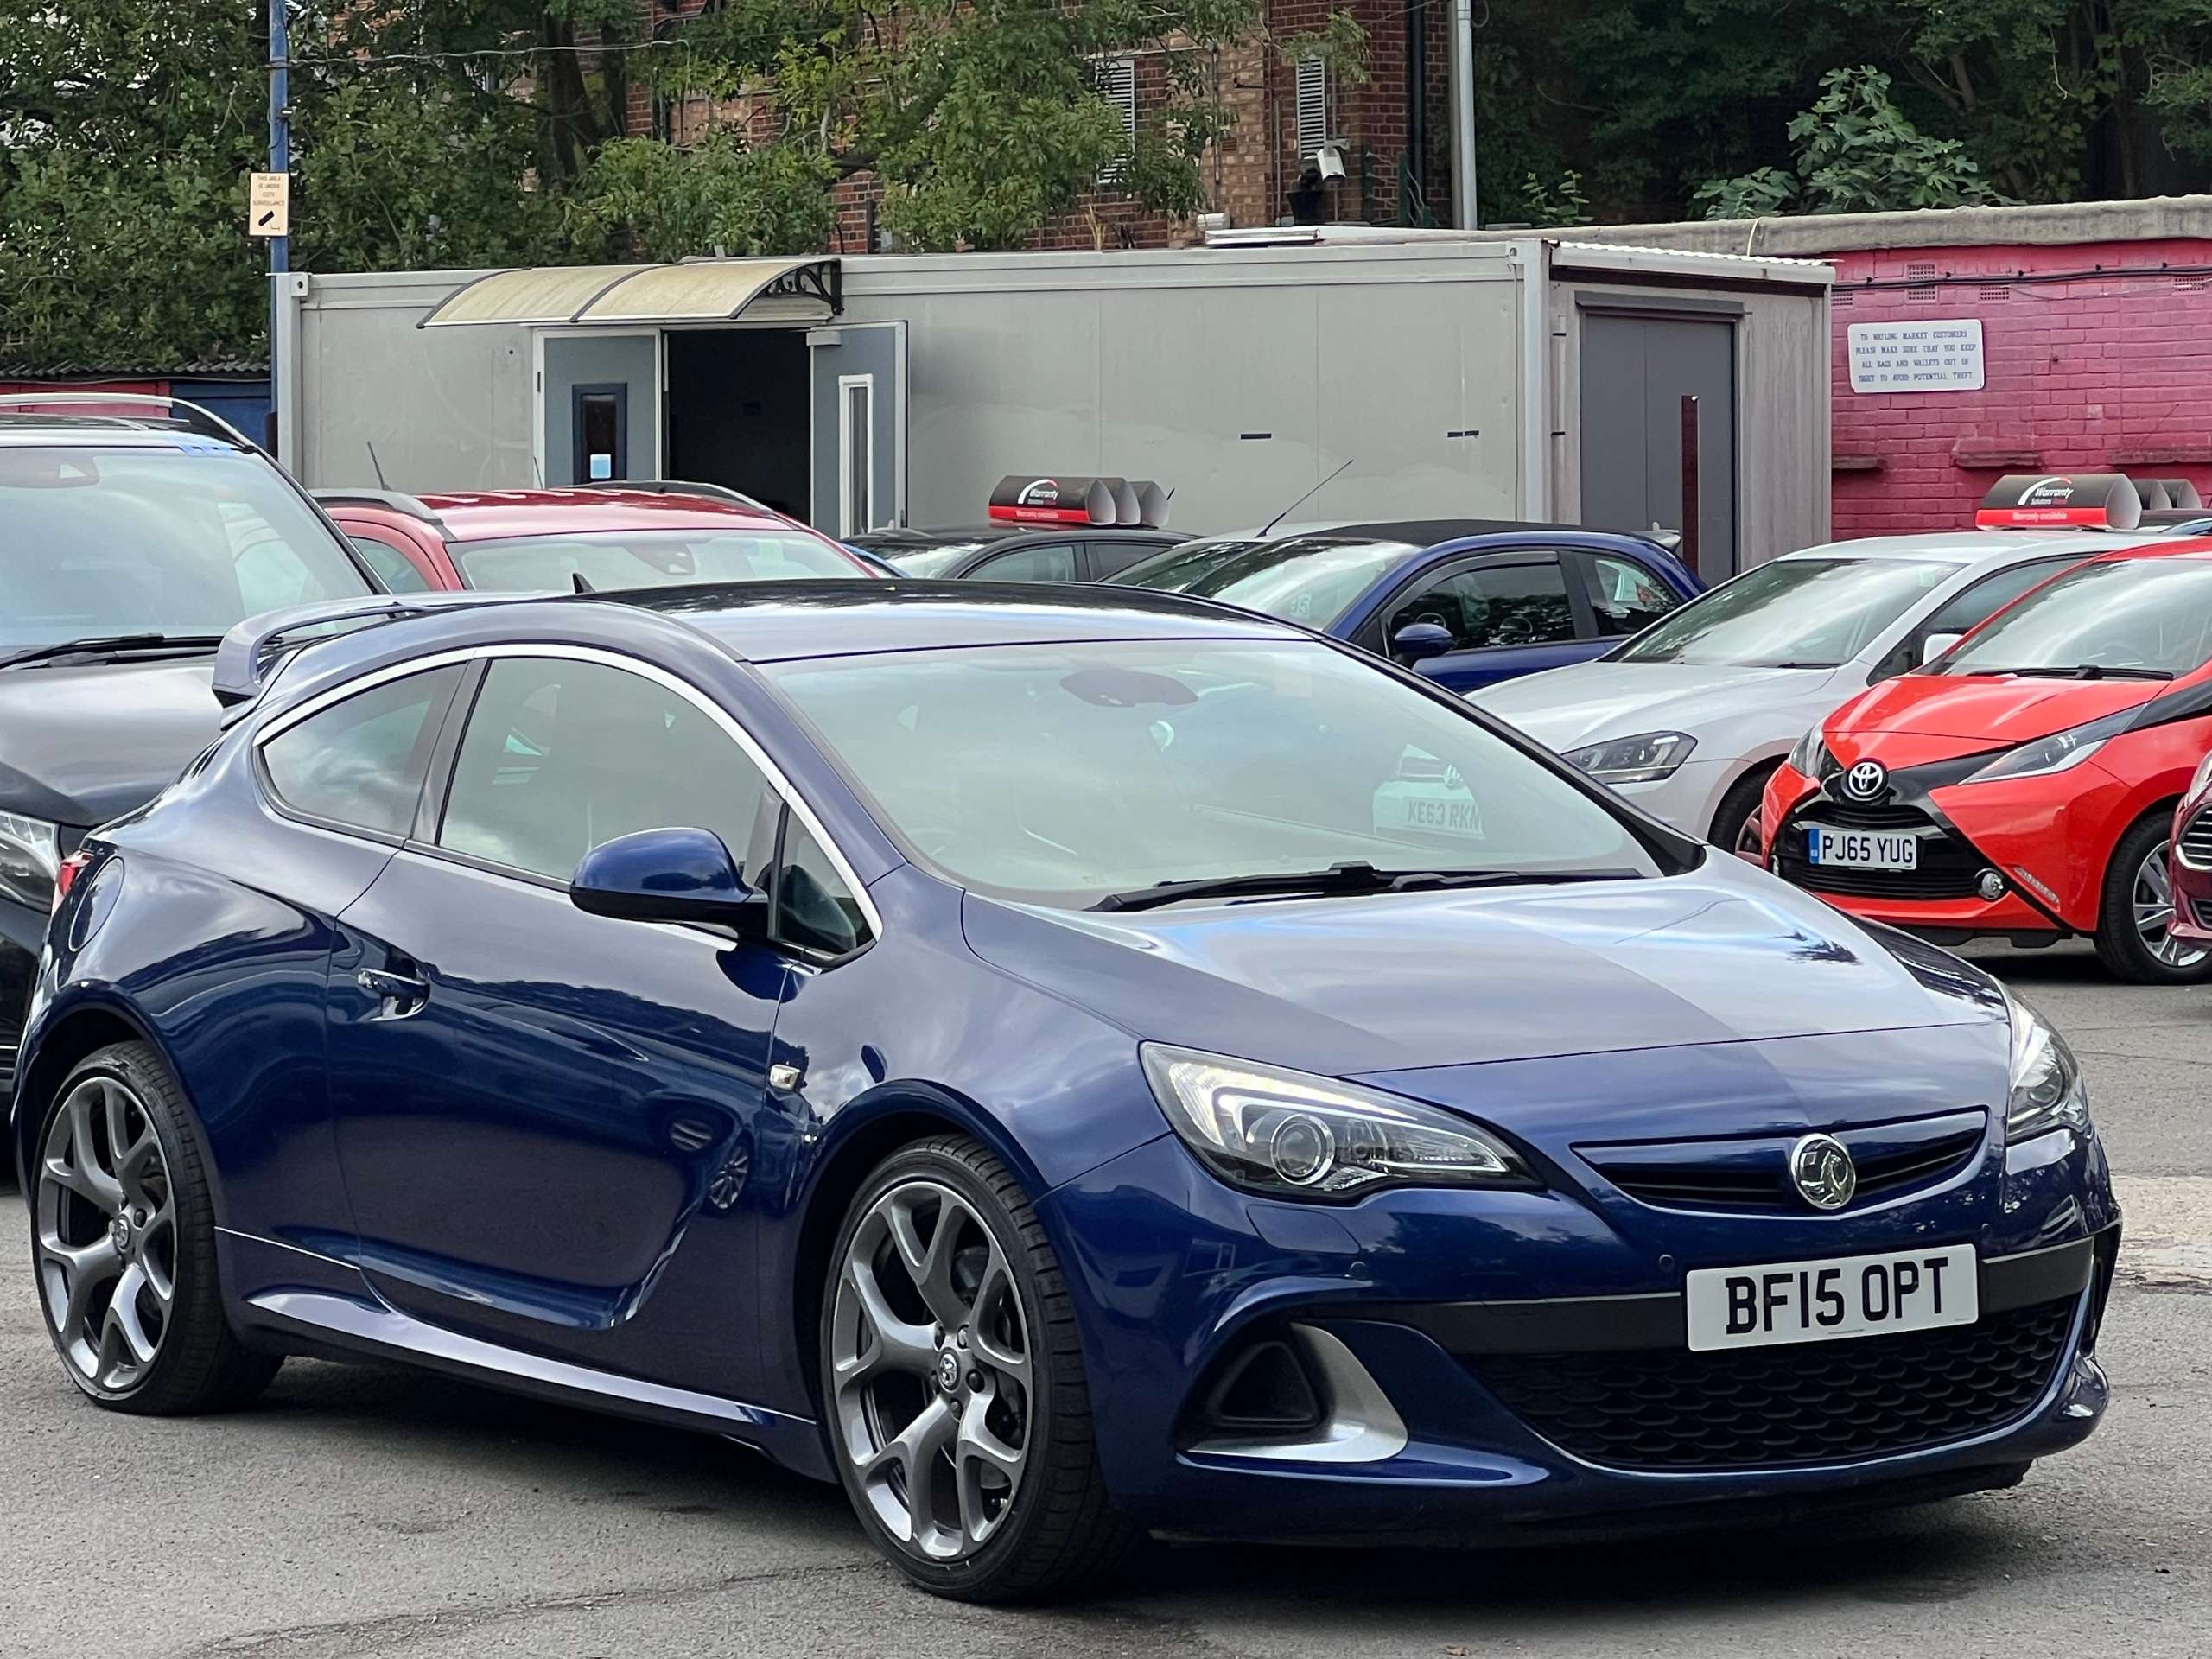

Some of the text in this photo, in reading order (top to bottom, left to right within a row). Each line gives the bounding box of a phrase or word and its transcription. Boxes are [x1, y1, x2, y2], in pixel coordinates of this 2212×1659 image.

[1860, 333, 1868, 341] TO
[1933, 330, 1967, 339] CUSTOMERS
[1961, 343, 1977, 352] KEEP
[1953, 372, 1973, 380] THEFT
[1029, 488, 1059, 500] Warranty
[2035, 486, 2074, 499] Warranty
[1408, 800, 1480, 832] KE63 RKN
[1822, 835, 1913, 863] PJ65 YUG
[1724, 1256, 1948, 1335] BF15 OPT
